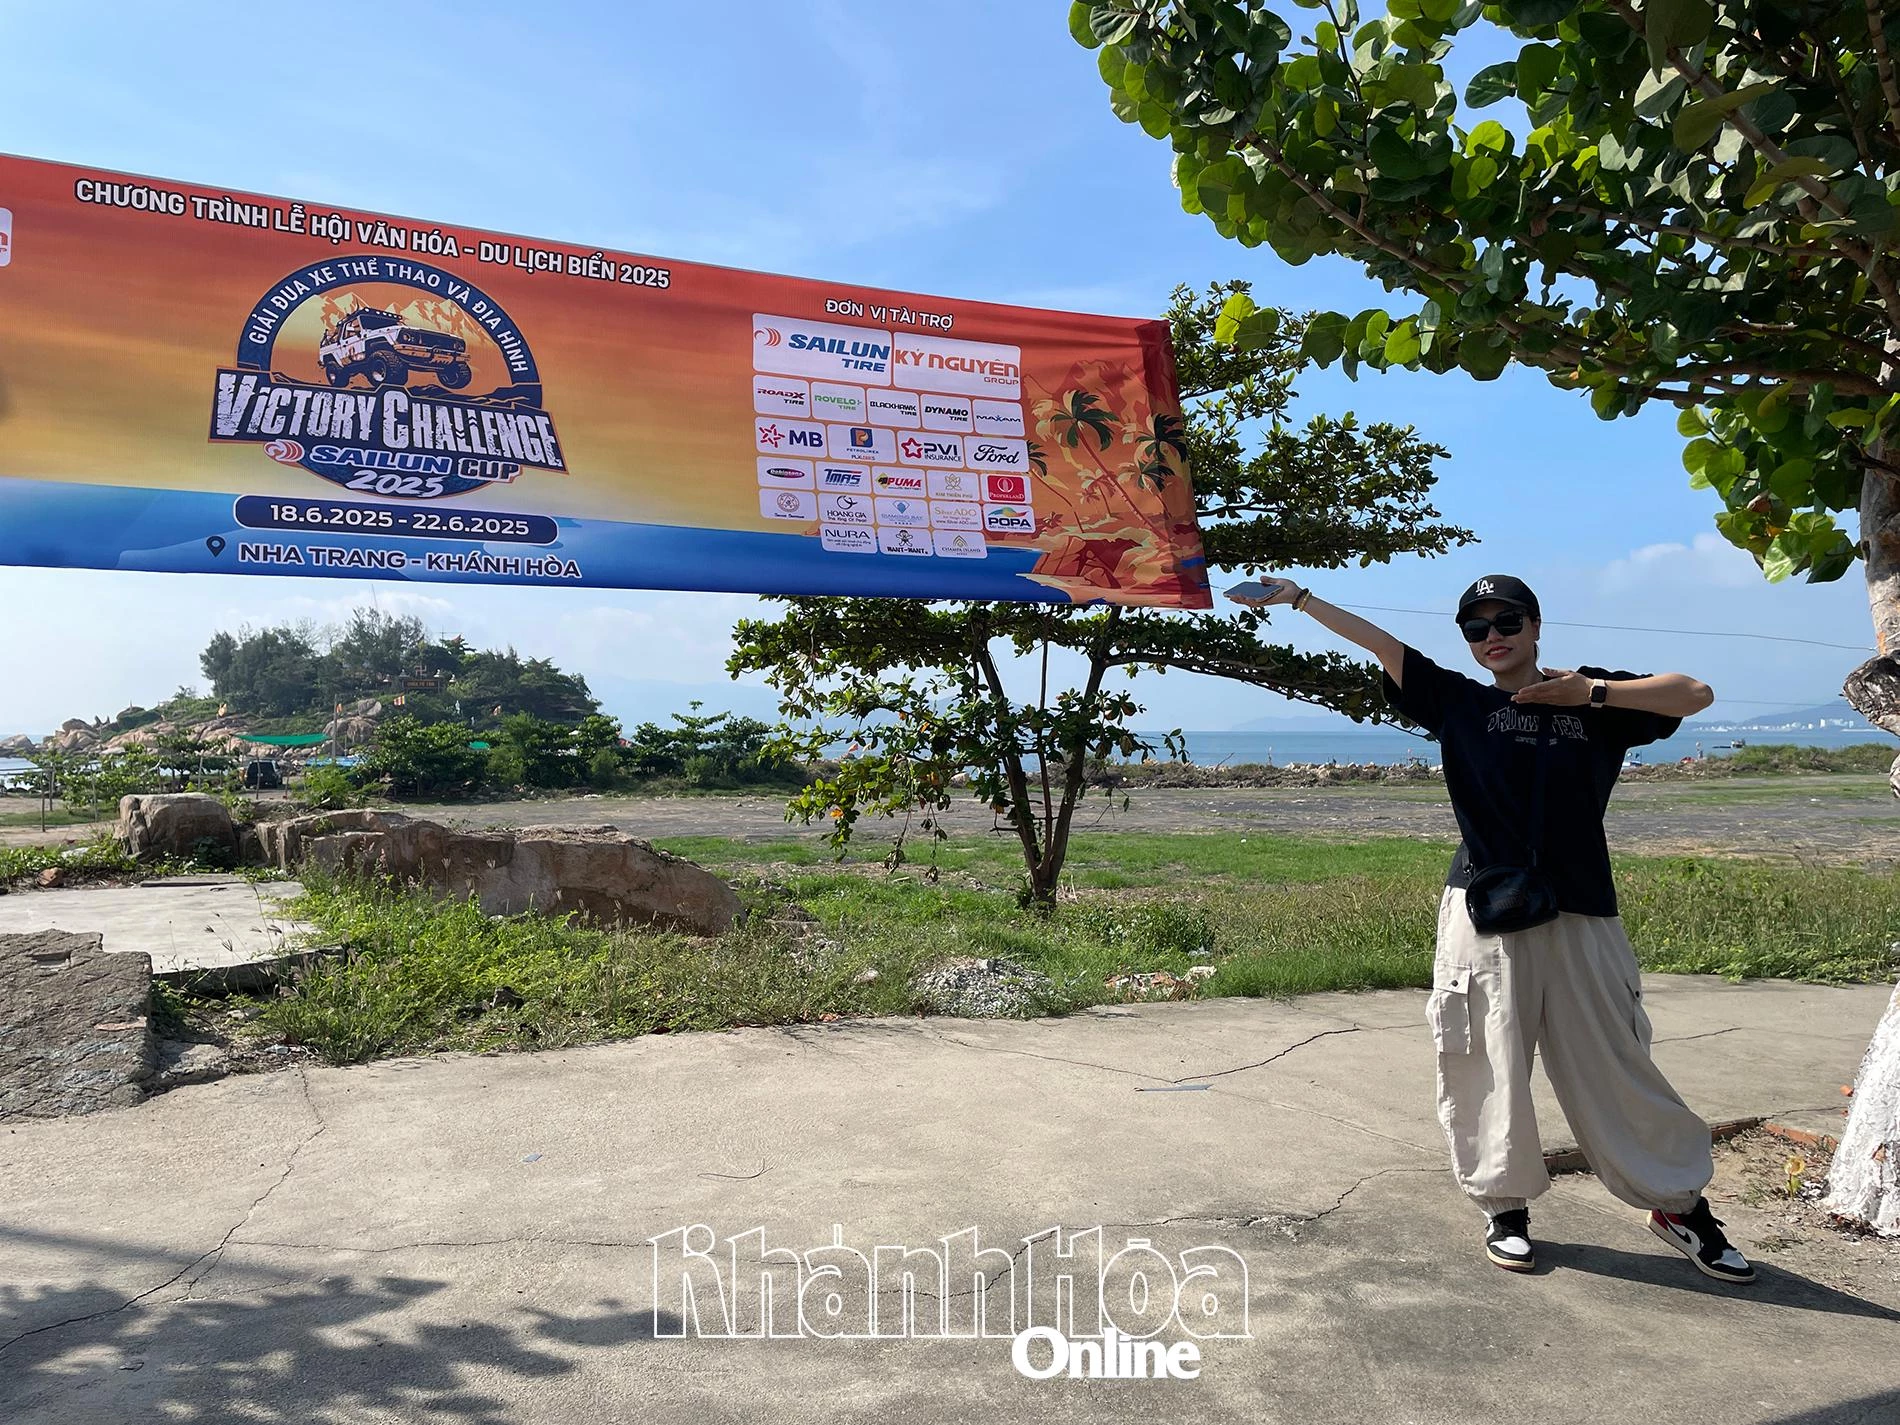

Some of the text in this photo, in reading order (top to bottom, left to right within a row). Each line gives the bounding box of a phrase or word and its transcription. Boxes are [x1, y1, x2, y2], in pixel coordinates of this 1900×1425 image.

[76, 179, 185, 215] CHƯƠNG
[191, 196, 268, 228] TRÌNH
[274, 204, 306, 233] LỄ
[311, 213, 351, 245] HỘI
[357, 221, 406, 249] VĂN
[412, 230, 458, 257] HÓA
[480, 242, 509, 265] DU
[515, 249, 562, 274] LỊCH
[568, 251, 615, 281] BIỂN
[620, 265, 670, 289] 2025
[249, 258, 529, 373] GIẢI ĐUA XE THỂ THAO VÀ ĐỊA HÌNH
[825, 299, 954, 331] ĐƠN VỊ TÀI TRỢ
[788, 333, 890, 360] SAILUN
[841, 358, 886, 373] TIRE
[983, 376, 1020, 386] GROUP
[757, 388, 806, 399] ROADX
[814, 395, 856, 405] ROVELO
[784, 398, 805, 406] TIRE
[870, 401, 917, 411] BLACKHAWK
[924, 406, 969, 417] DYNAMO
[976, 414, 1021, 423] MAXAM
[383, 390, 563, 467] CHALLENGE
[789, 430, 824, 448] MB
[923, 443, 958, 456] PVI
[973, 444, 1020, 464] Ford
[309, 445, 521, 482] SAILUN CUP
[924, 453, 962, 462] INSURANCE
[345, 469, 444, 497] 2025
[887, 477, 922, 488] PUMA
[270, 503, 392, 528] 18.6.2025
[412, 513, 530, 536] 22.6.2025
[988, 517, 1032, 528] POPA
[825, 529, 870, 540] NURA
[240, 543, 305, 565] NHA
[308, 547, 406, 569] TRANG
[426, 552, 520, 575] KHÁNH
[524, 555, 582, 579] HÒA
[1475, 578, 1495, 597] LA
